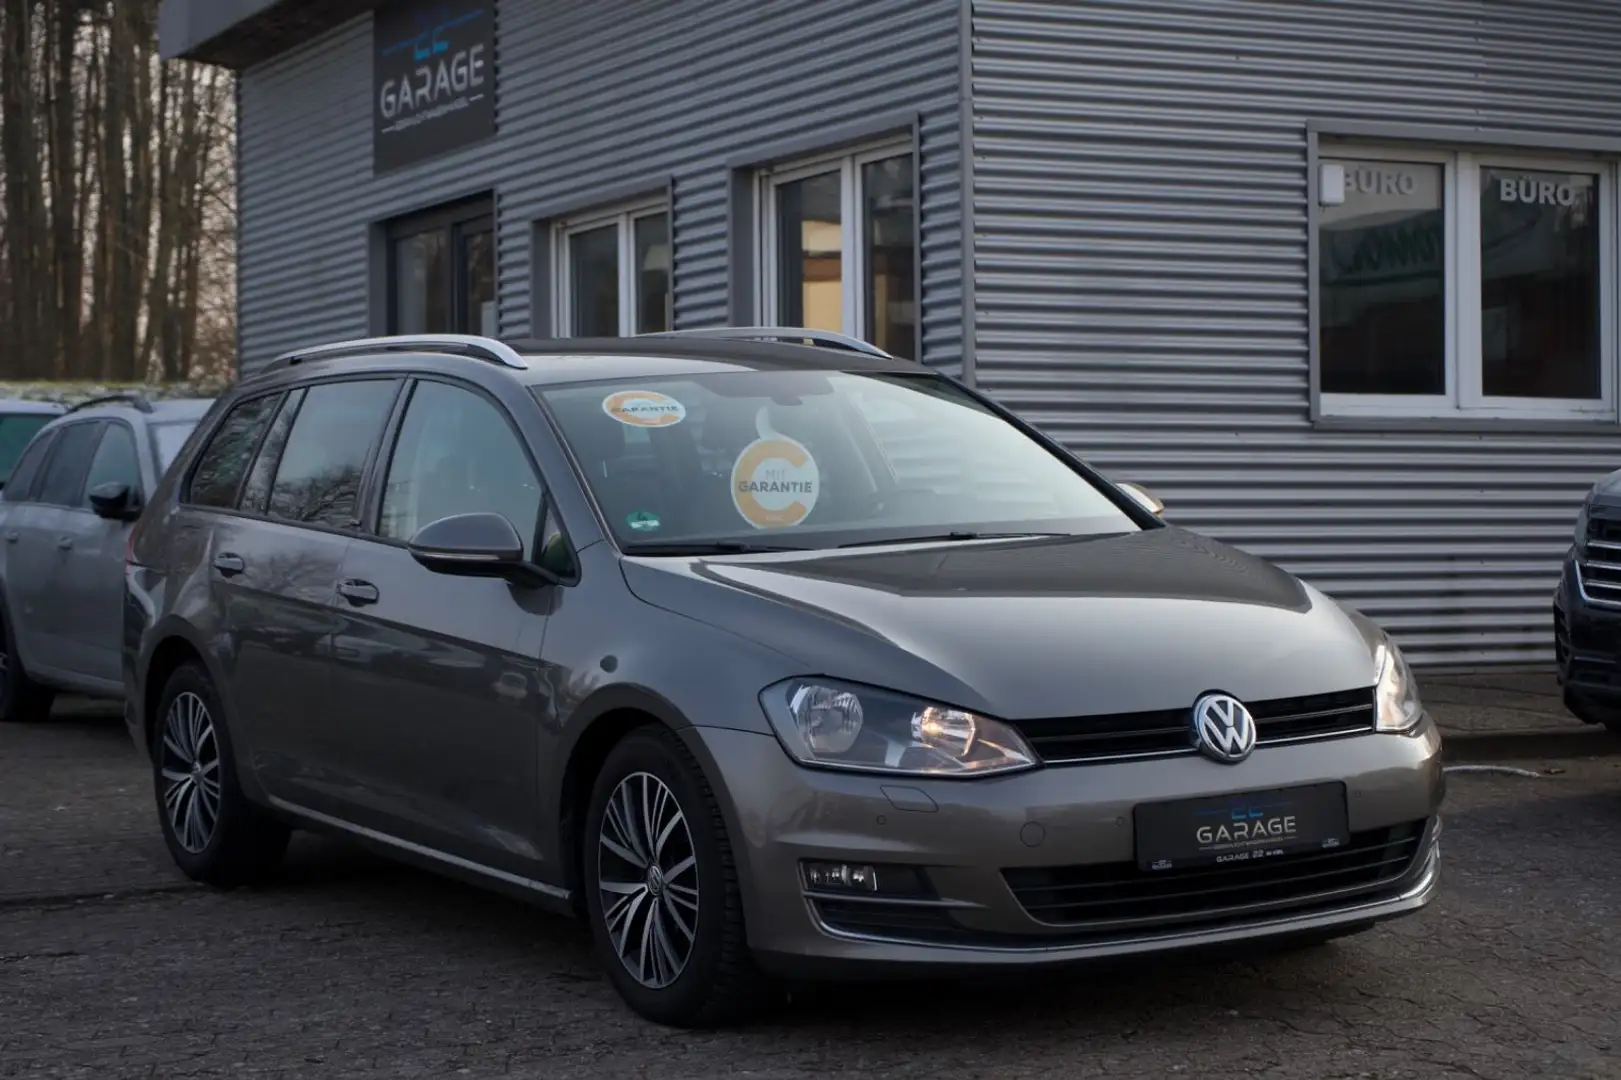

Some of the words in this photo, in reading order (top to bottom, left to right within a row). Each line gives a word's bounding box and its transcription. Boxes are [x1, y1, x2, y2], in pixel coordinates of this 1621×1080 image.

[381, 43, 484, 119] GARAGE
[1501, 175, 1575, 206] BÜRO
[738, 481, 812, 493] GARANTIE
[1197, 693, 1256, 759] VW
[1196, 816, 1297, 844] GARAGE
